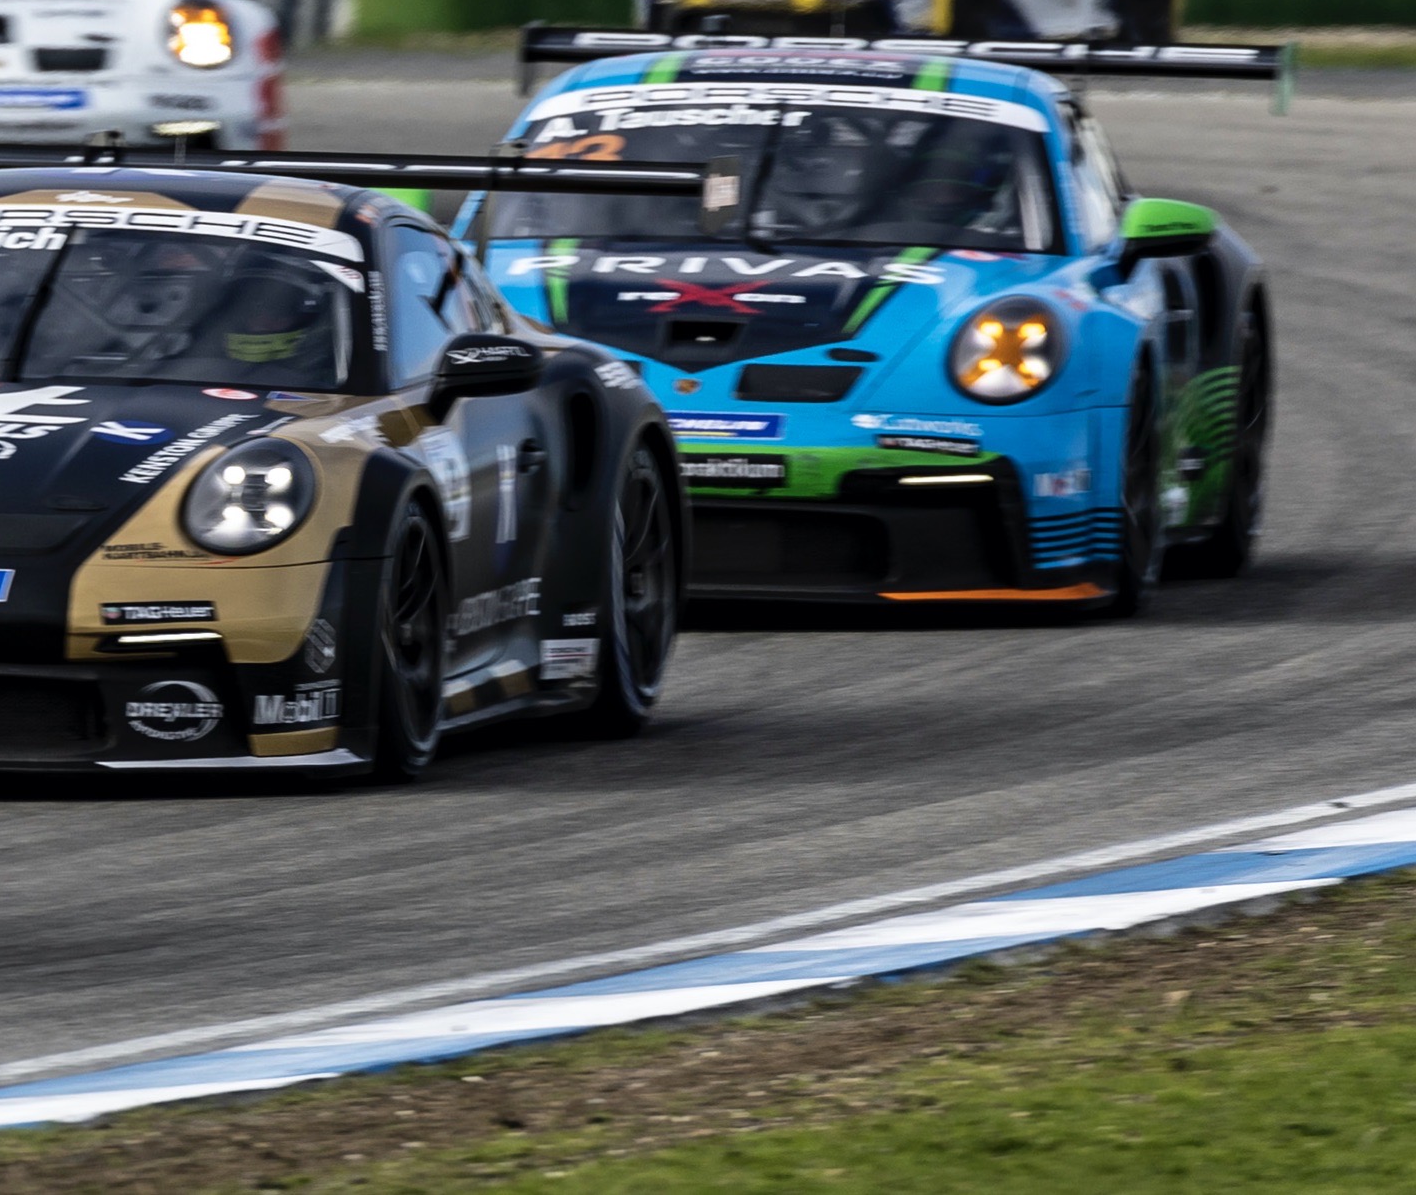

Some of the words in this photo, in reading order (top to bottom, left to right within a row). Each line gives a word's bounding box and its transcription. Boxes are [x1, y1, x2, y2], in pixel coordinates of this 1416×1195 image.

[572, 31, 1265, 64] PORSCHE
[594, 104, 813, 132] Tauscher
[505, 254, 947, 286] PRIVAS
